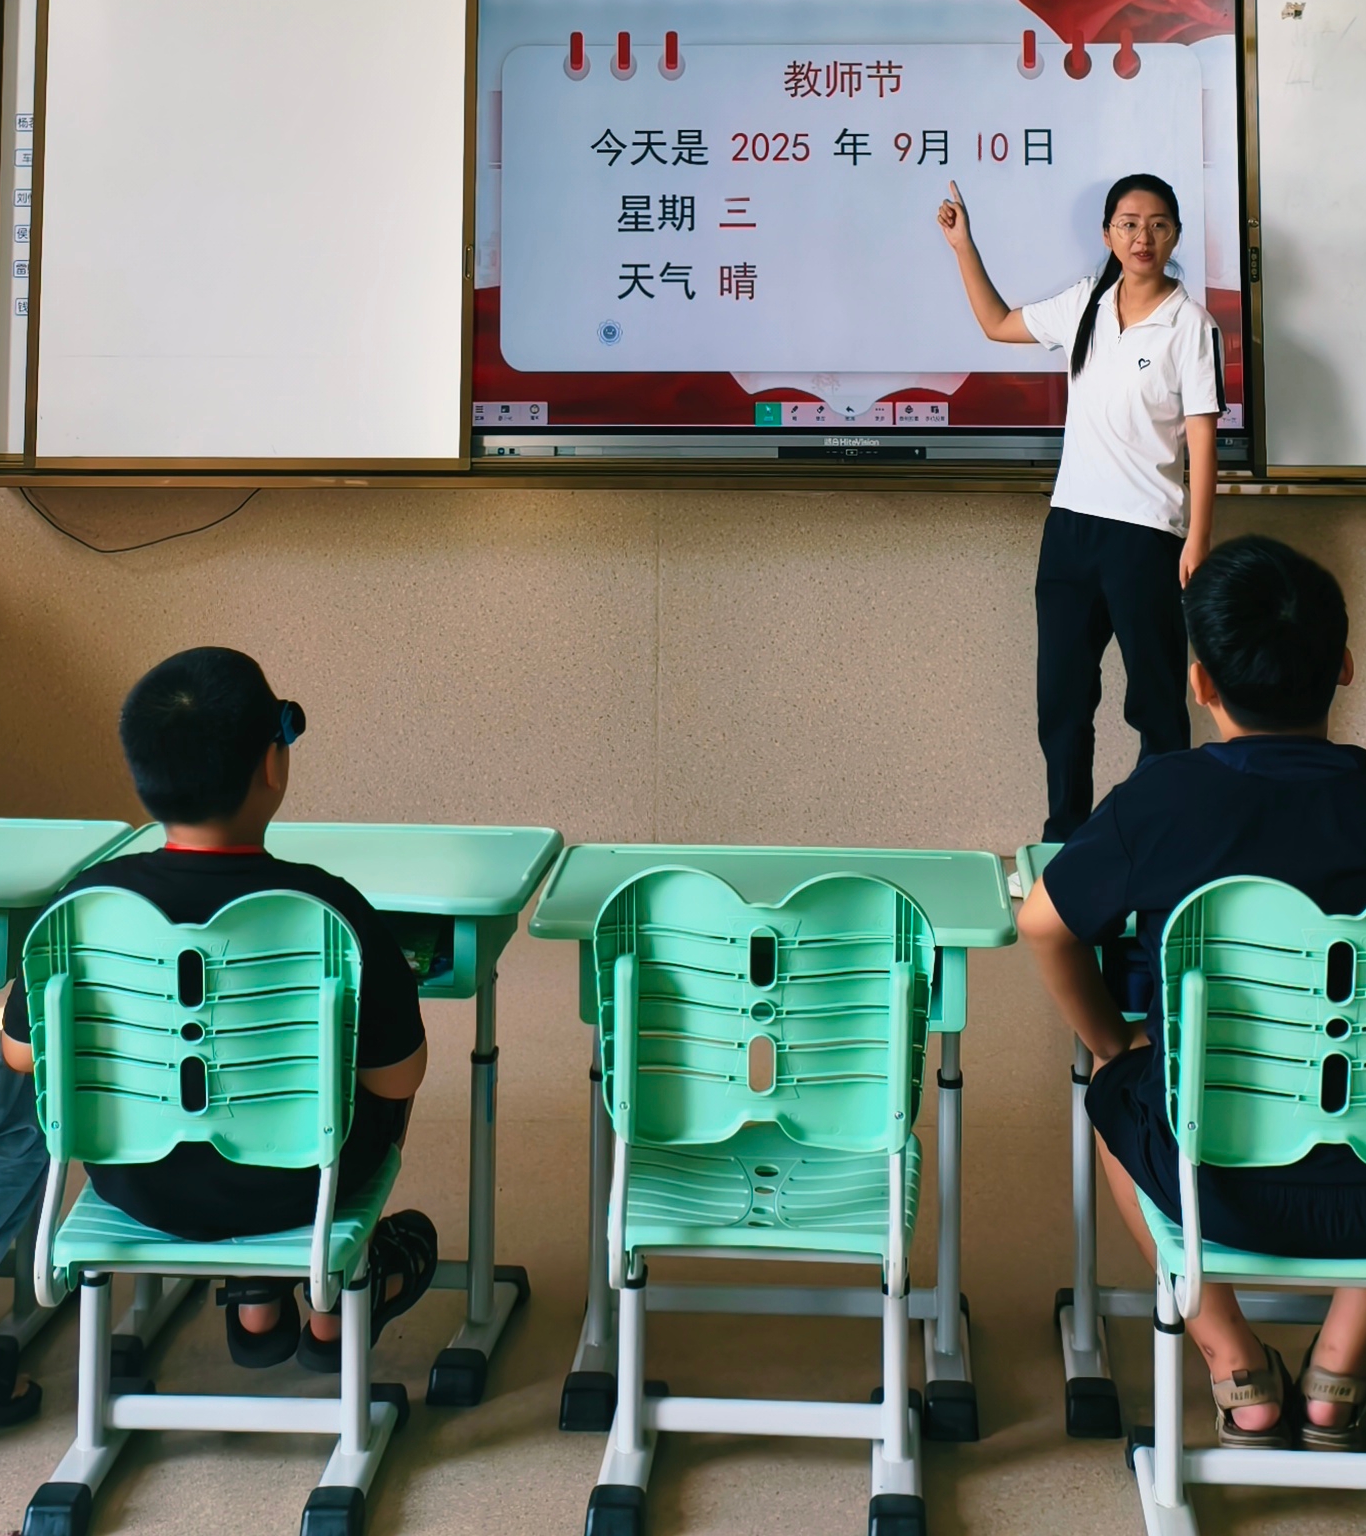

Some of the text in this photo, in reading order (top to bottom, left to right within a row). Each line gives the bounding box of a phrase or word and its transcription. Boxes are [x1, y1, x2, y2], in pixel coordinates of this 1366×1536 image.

[784, 60, 903, 98] 教师节
[590, 128, 1053, 167] 今天是 2025 年 9月 10 日
[617, 194, 756, 232] 星期 三
[617, 262, 758, 300] 天气 晴
